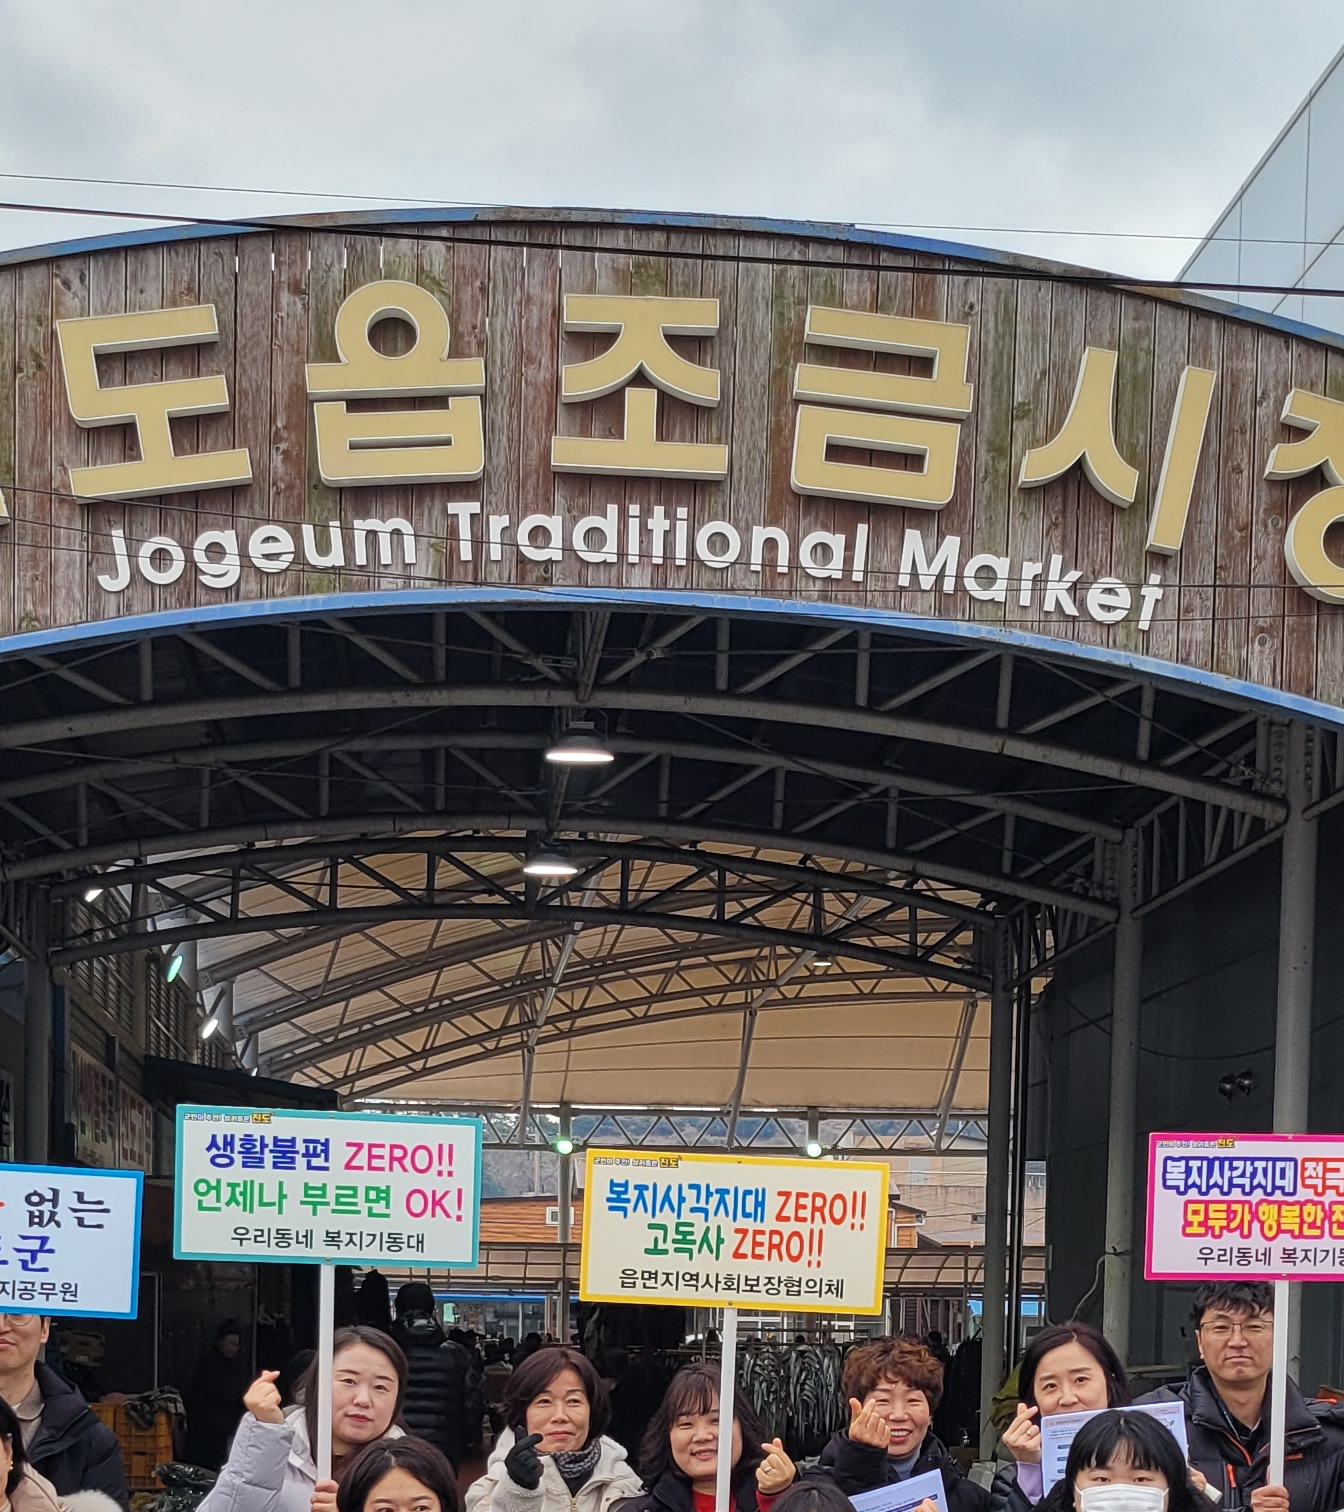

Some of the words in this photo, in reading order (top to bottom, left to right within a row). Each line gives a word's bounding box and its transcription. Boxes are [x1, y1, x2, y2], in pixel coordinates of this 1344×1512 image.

[98, 516, 418, 593] Jogeum
[446, 500, 868, 583] Traditional
[899, 526, 1164, 632] Market
[205, 1133, 331, 1172] 생활불편
[343, 1141, 455, 1178] ZERO!!
[1163, 1157, 1297, 1195] 복지사각지대
[24, 1187, 111, 1229] 없는
[193, 1178, 288, 1216] 언제나
[299, 1182, 392, 1219] 부르면
[405, 1187, 464, 1222] OK!
[606, 1178, 767, 1224] 복지사각지대
[774, 1190, 868, 1232] ZERO!!
[1183, 1200, 1252, 1238] 모두가
[1257, 1200, 1324, 1241] 행복한
[231, 1226, 314, 1250] 우리동네
[323, 1229, 425, 1253] 복지기동대
[643, 1221, 725, 1262] 고독사
[731, 1227, 824, 1268] ZERO!!
[1197, 1246, 1272, 1268] 우리동네
[618, 1267, 845, 1299] 읍면지역사회보장협의체
